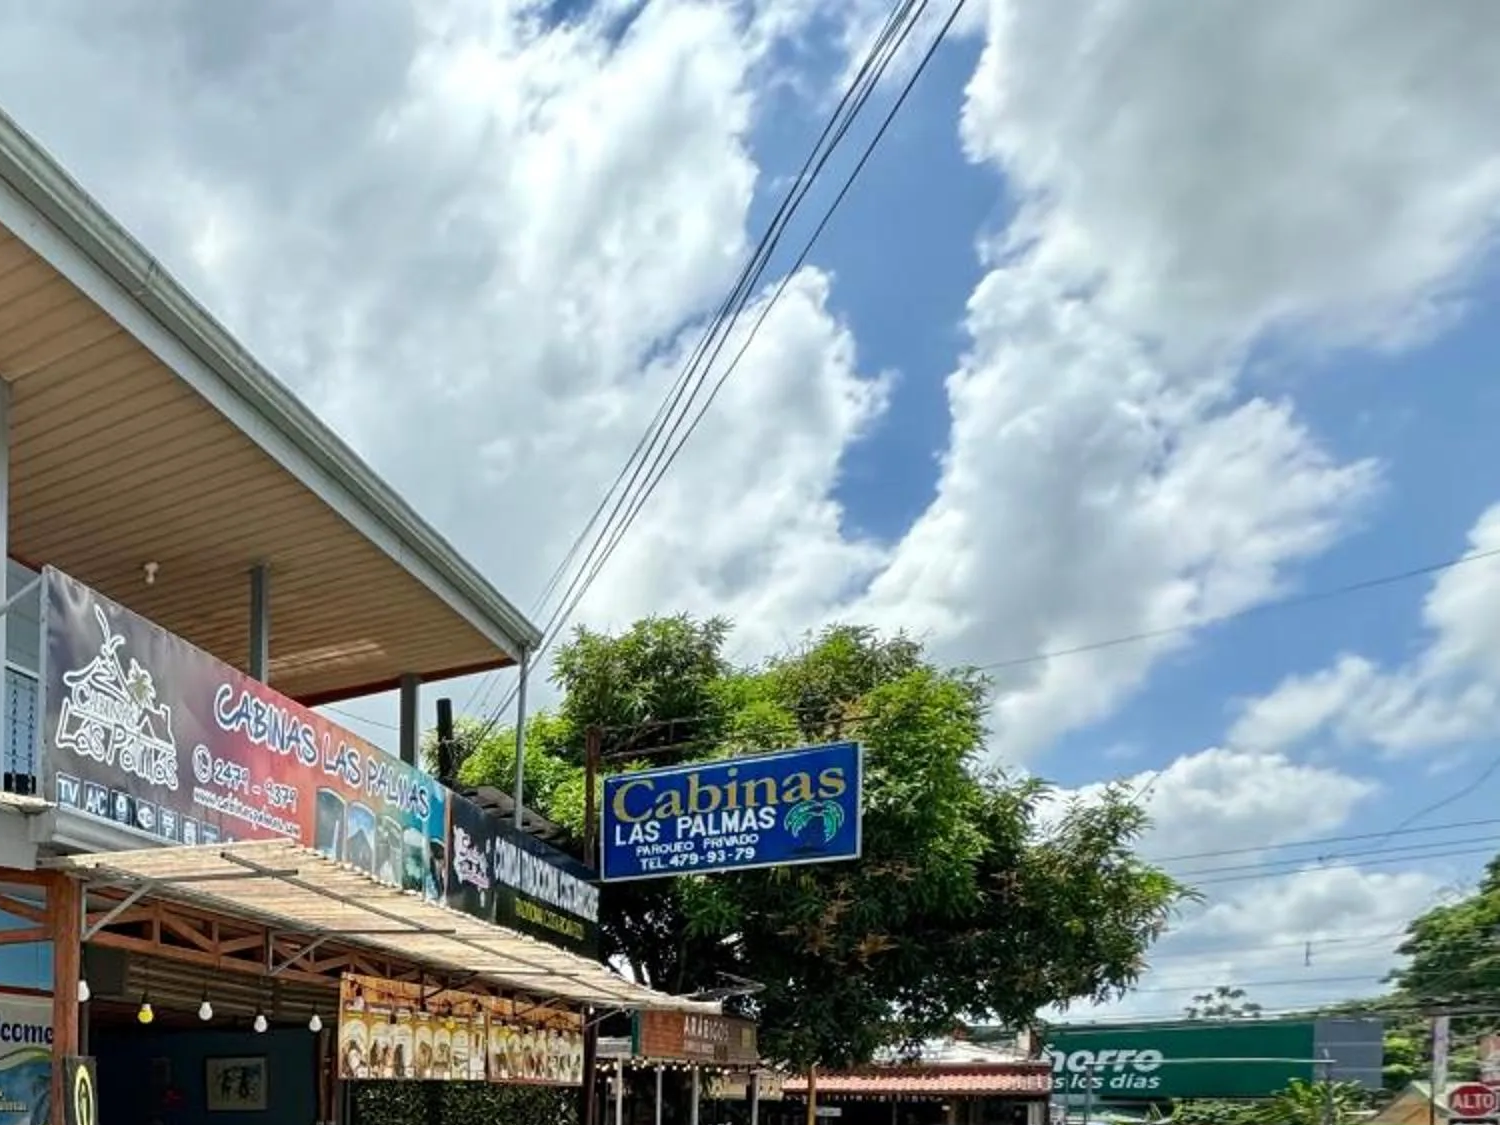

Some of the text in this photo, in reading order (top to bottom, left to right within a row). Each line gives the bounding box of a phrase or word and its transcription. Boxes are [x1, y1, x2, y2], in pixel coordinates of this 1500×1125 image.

[214, 684, 431, 822] CABINAS LAS PALMAS
[613, 767, 847, 823] Cabinas
[615, 806, 776, 847] LAS PALMAS
[636, 833, 759, 857] PARQUEO PRIVADO
[669, 847, 756, 868] 479-93-79
[1040, 1044, 1164, 1073] horro
[1452, 1092, 1496, 1110] ALTO
